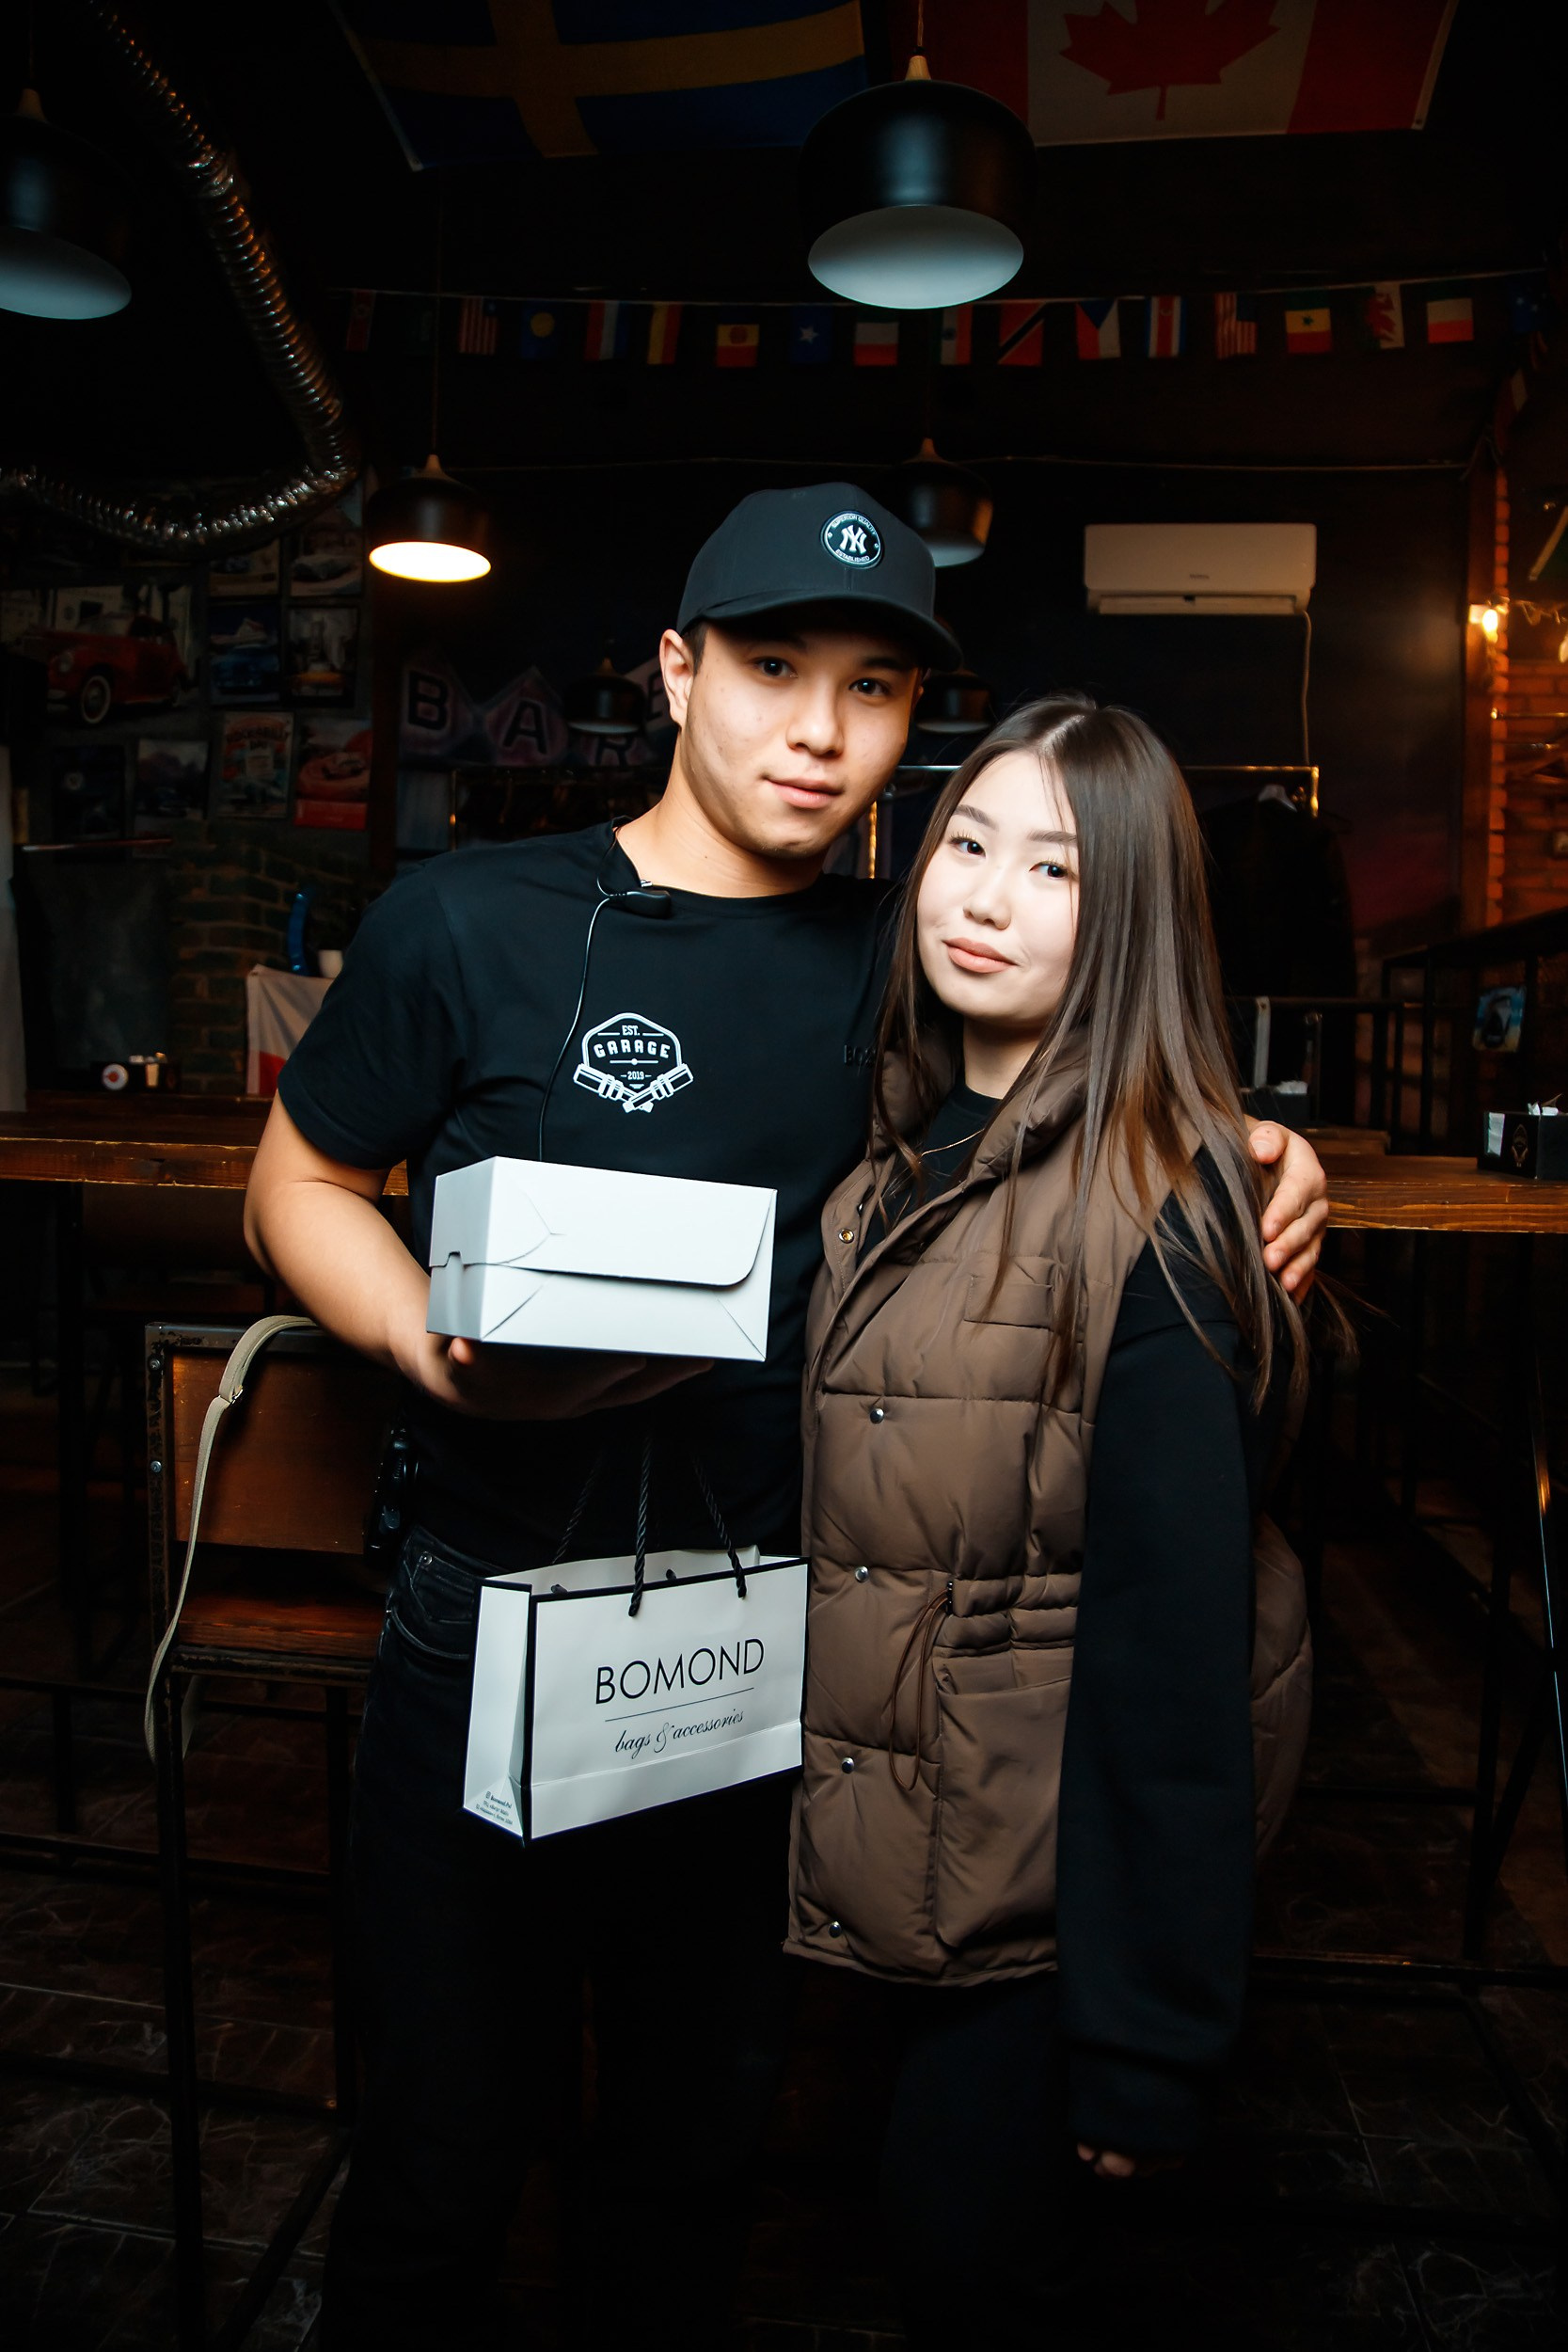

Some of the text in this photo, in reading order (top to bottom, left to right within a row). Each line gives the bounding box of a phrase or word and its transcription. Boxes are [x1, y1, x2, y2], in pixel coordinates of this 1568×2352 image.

[840, 524, 867, 555] NY
[622, 1025, 641, 1036] EST.
[593, 1039, 671, 1058] GARAGE
[626, 1071, 645, 1081] 2019
[595, 1638, 765, 1705] BOMOND
[615, 1708, 744, 1760] bags & accessories
